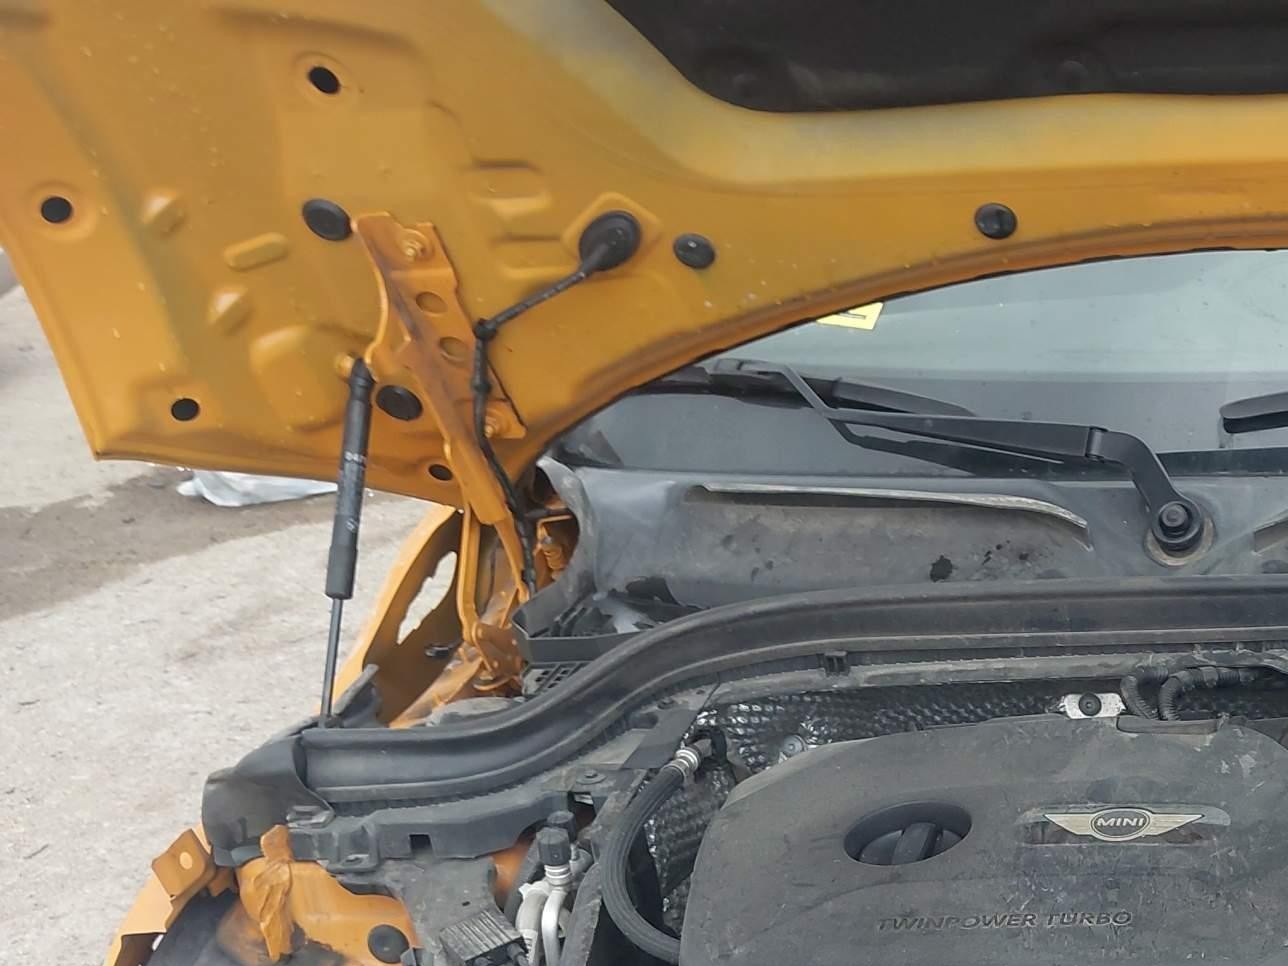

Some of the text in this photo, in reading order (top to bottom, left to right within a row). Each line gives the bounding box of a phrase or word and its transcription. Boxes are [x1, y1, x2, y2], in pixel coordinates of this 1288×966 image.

[1096, 816, 1146, 828] MINI
[878, 910, 1133, 931] TWINPOWER TURBO
